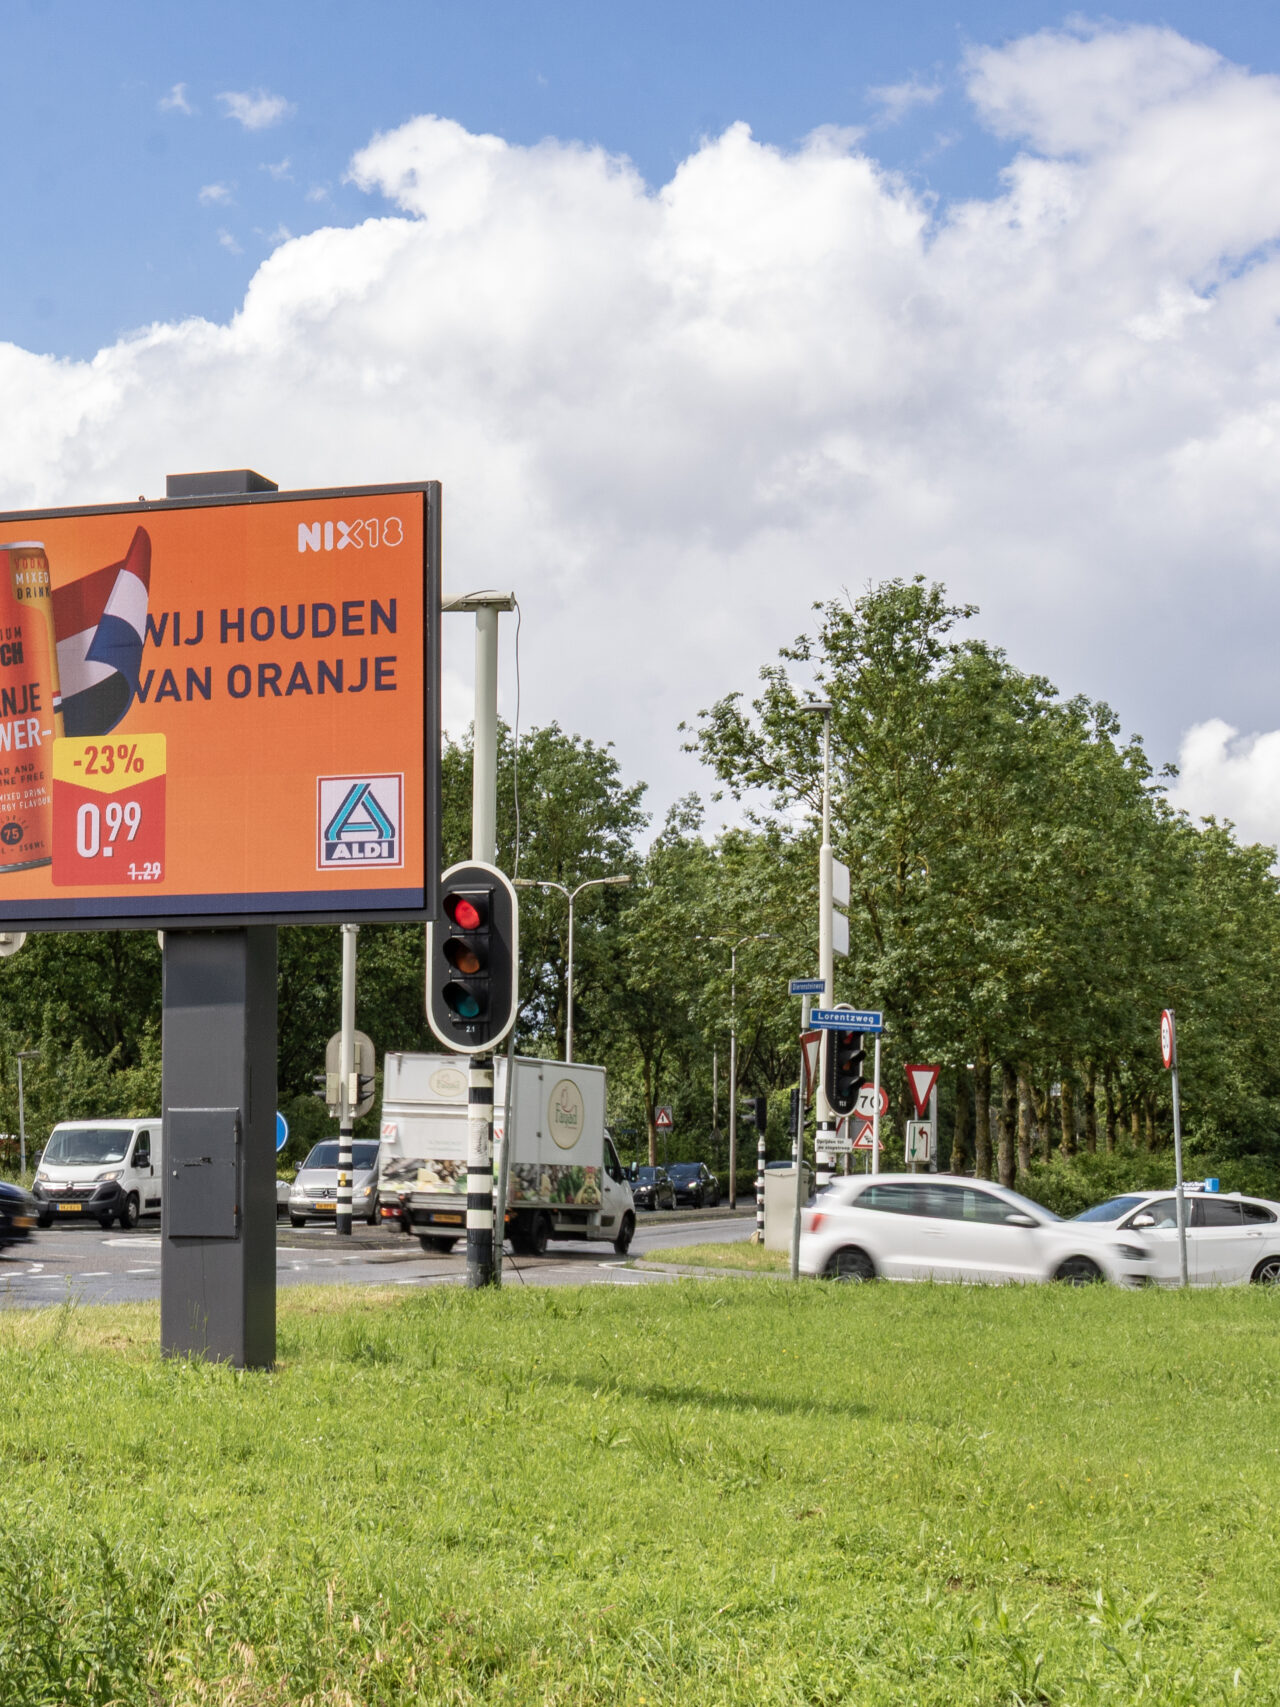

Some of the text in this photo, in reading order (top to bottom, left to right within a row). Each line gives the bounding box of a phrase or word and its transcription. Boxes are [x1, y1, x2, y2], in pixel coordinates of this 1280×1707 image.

[298, 516, 403, 552] NIX18
[16, 571, 49, 584] MIXED
[17, 586, 50, 600] DRINK
[144, 598, 397, 647] WIJ HOUDEN
[134, 656, 397, 703] VAN ORANJE
[74, 744, 144, 776] -23%
[15, 763, 34, 774] AND
[21, 771, 44, 784] FREE
[24, 786, 46, 798] DRINK
[20, 796, 51, 809] FLAVOUR
[4, 828, 19, 840] 75
[76, 801, 142, 858] 0.99
[331, 842, 388, 859] ALDI
[128, 862, 161, 881] 1.29
[818, 1012, 874, 1024] Lorentzweg
[860, 1096, 881, 1108] 70
